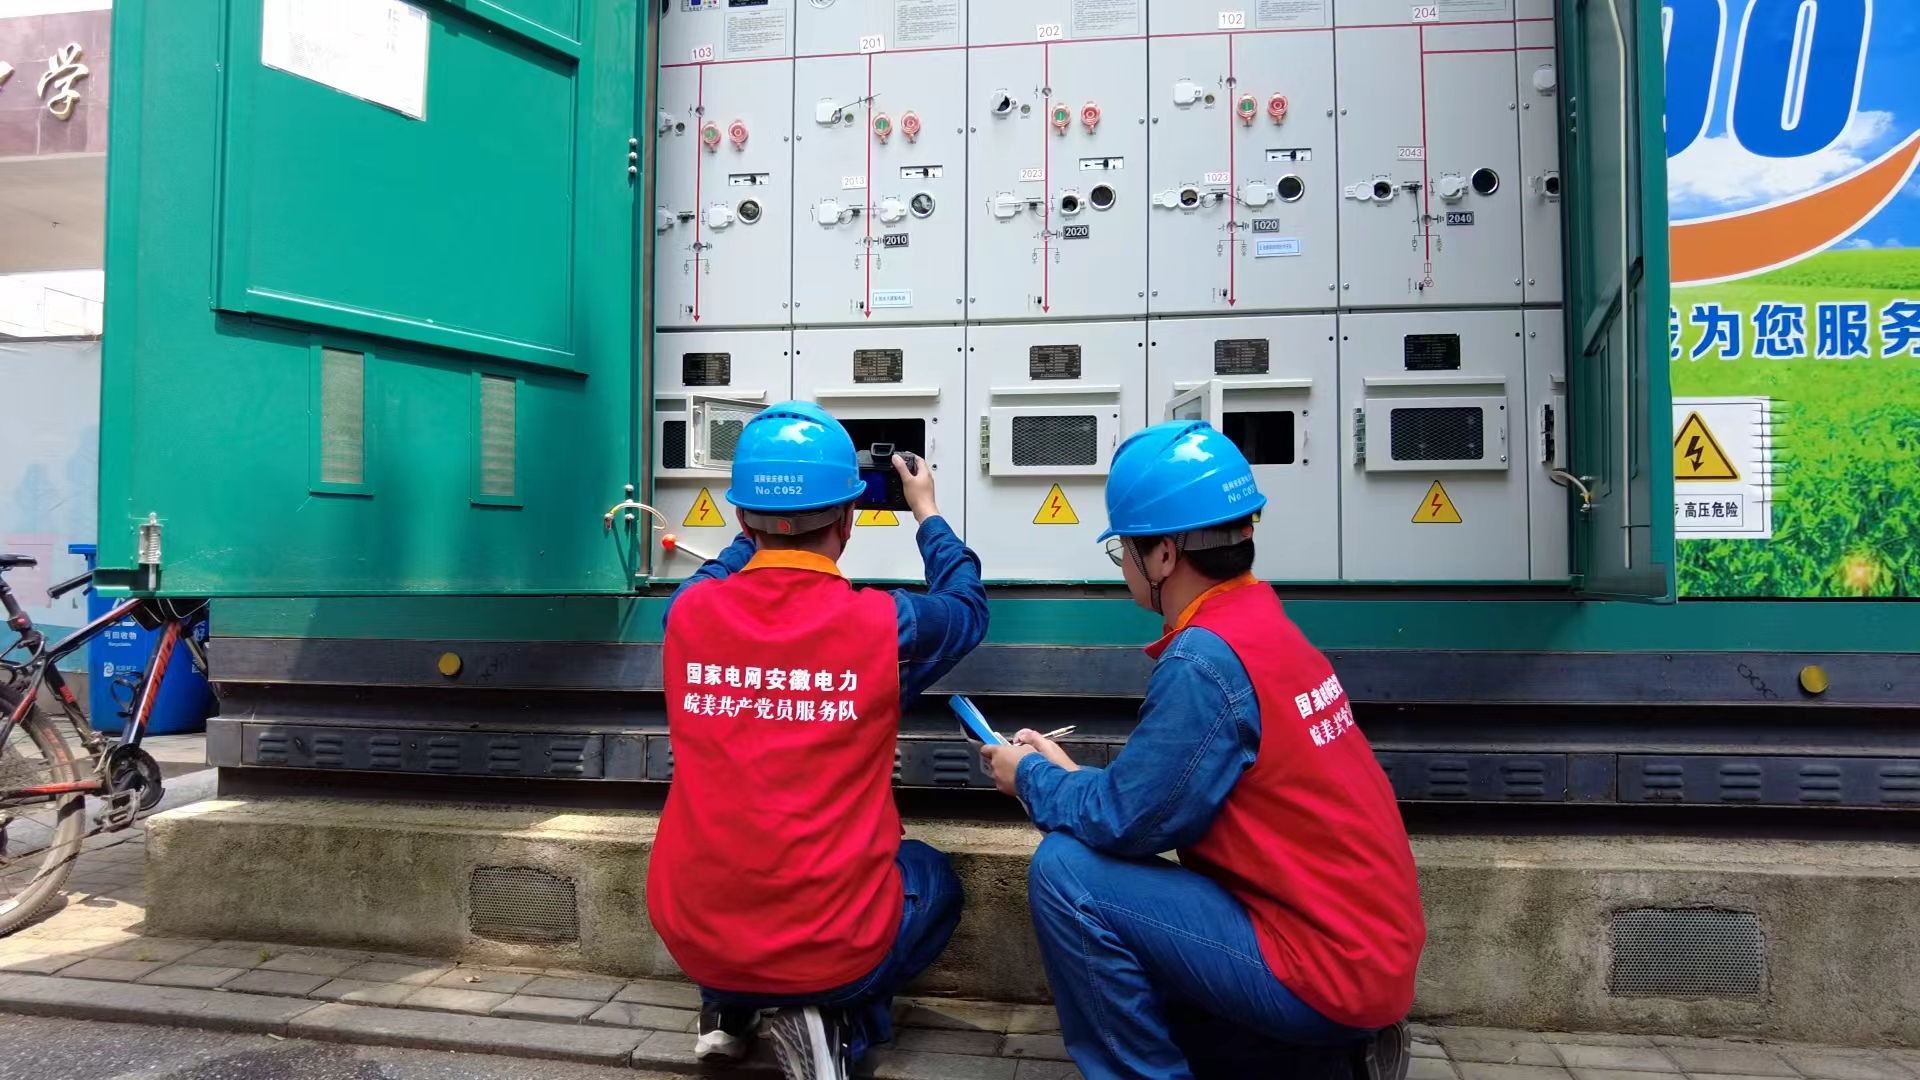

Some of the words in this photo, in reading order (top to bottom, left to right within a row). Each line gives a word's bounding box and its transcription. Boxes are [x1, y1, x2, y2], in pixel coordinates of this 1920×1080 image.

[1414, 7, 1437, 19] 204
[1221, 13, 1243, 25] 102
[1039, 25, 1060, 38] 202
[862, 37, 882, 50] 201
[692, 47, 712, 59] 103
[1399, 148, 1422, 158] 2043
[1022, 169, 1043, 179] 2023
[1206, 173, 1229, 183] 1023
[844, 176, 865, 187] 2013
[1448, 214, 1472, 224] 2040
[1254, 220, 1278, 230] 1020
[1065, 227, 1088, 237] 2020
[885, 235, 907, 245] 2010
[1684, 501, 1739, 518] 高压危险
[686, 662, 858, 692] 国家电网安徽电力
[683, 692, 859, 722] 皖美共产党员服务队
